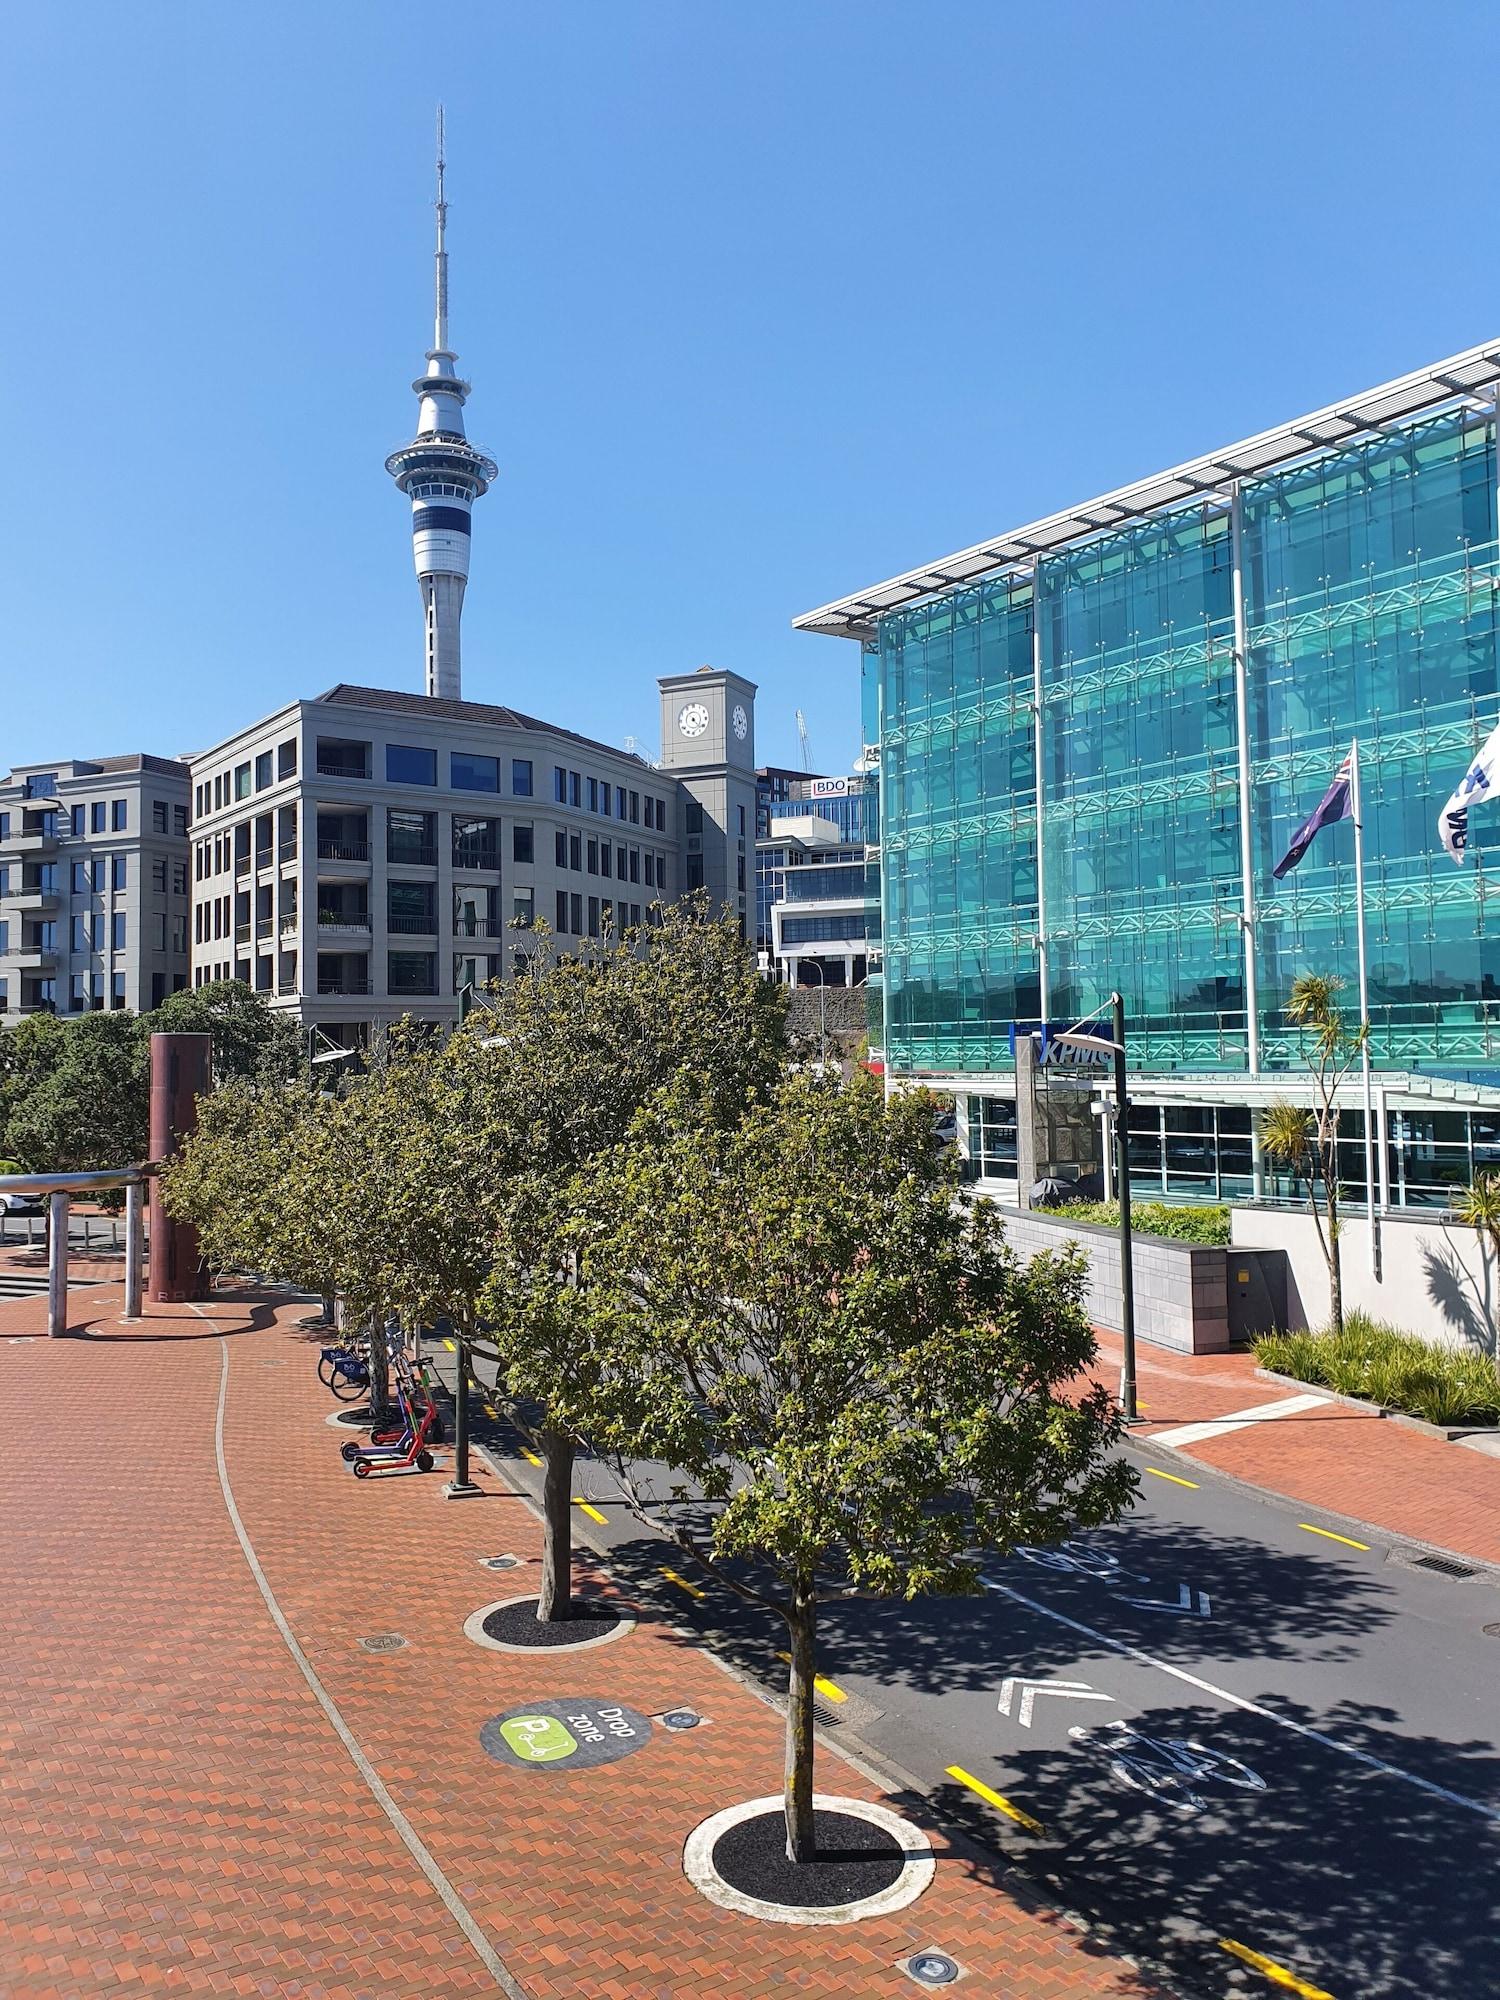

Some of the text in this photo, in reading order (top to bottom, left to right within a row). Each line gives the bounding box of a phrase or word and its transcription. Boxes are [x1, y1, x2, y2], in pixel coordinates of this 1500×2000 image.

[817, 780, 845, 792] BDO
[1041, 1041, 1112, 1064] KPMG
[567, 1713, 605, 1743] zone
[597, 1707, 636, 1738] Drop
